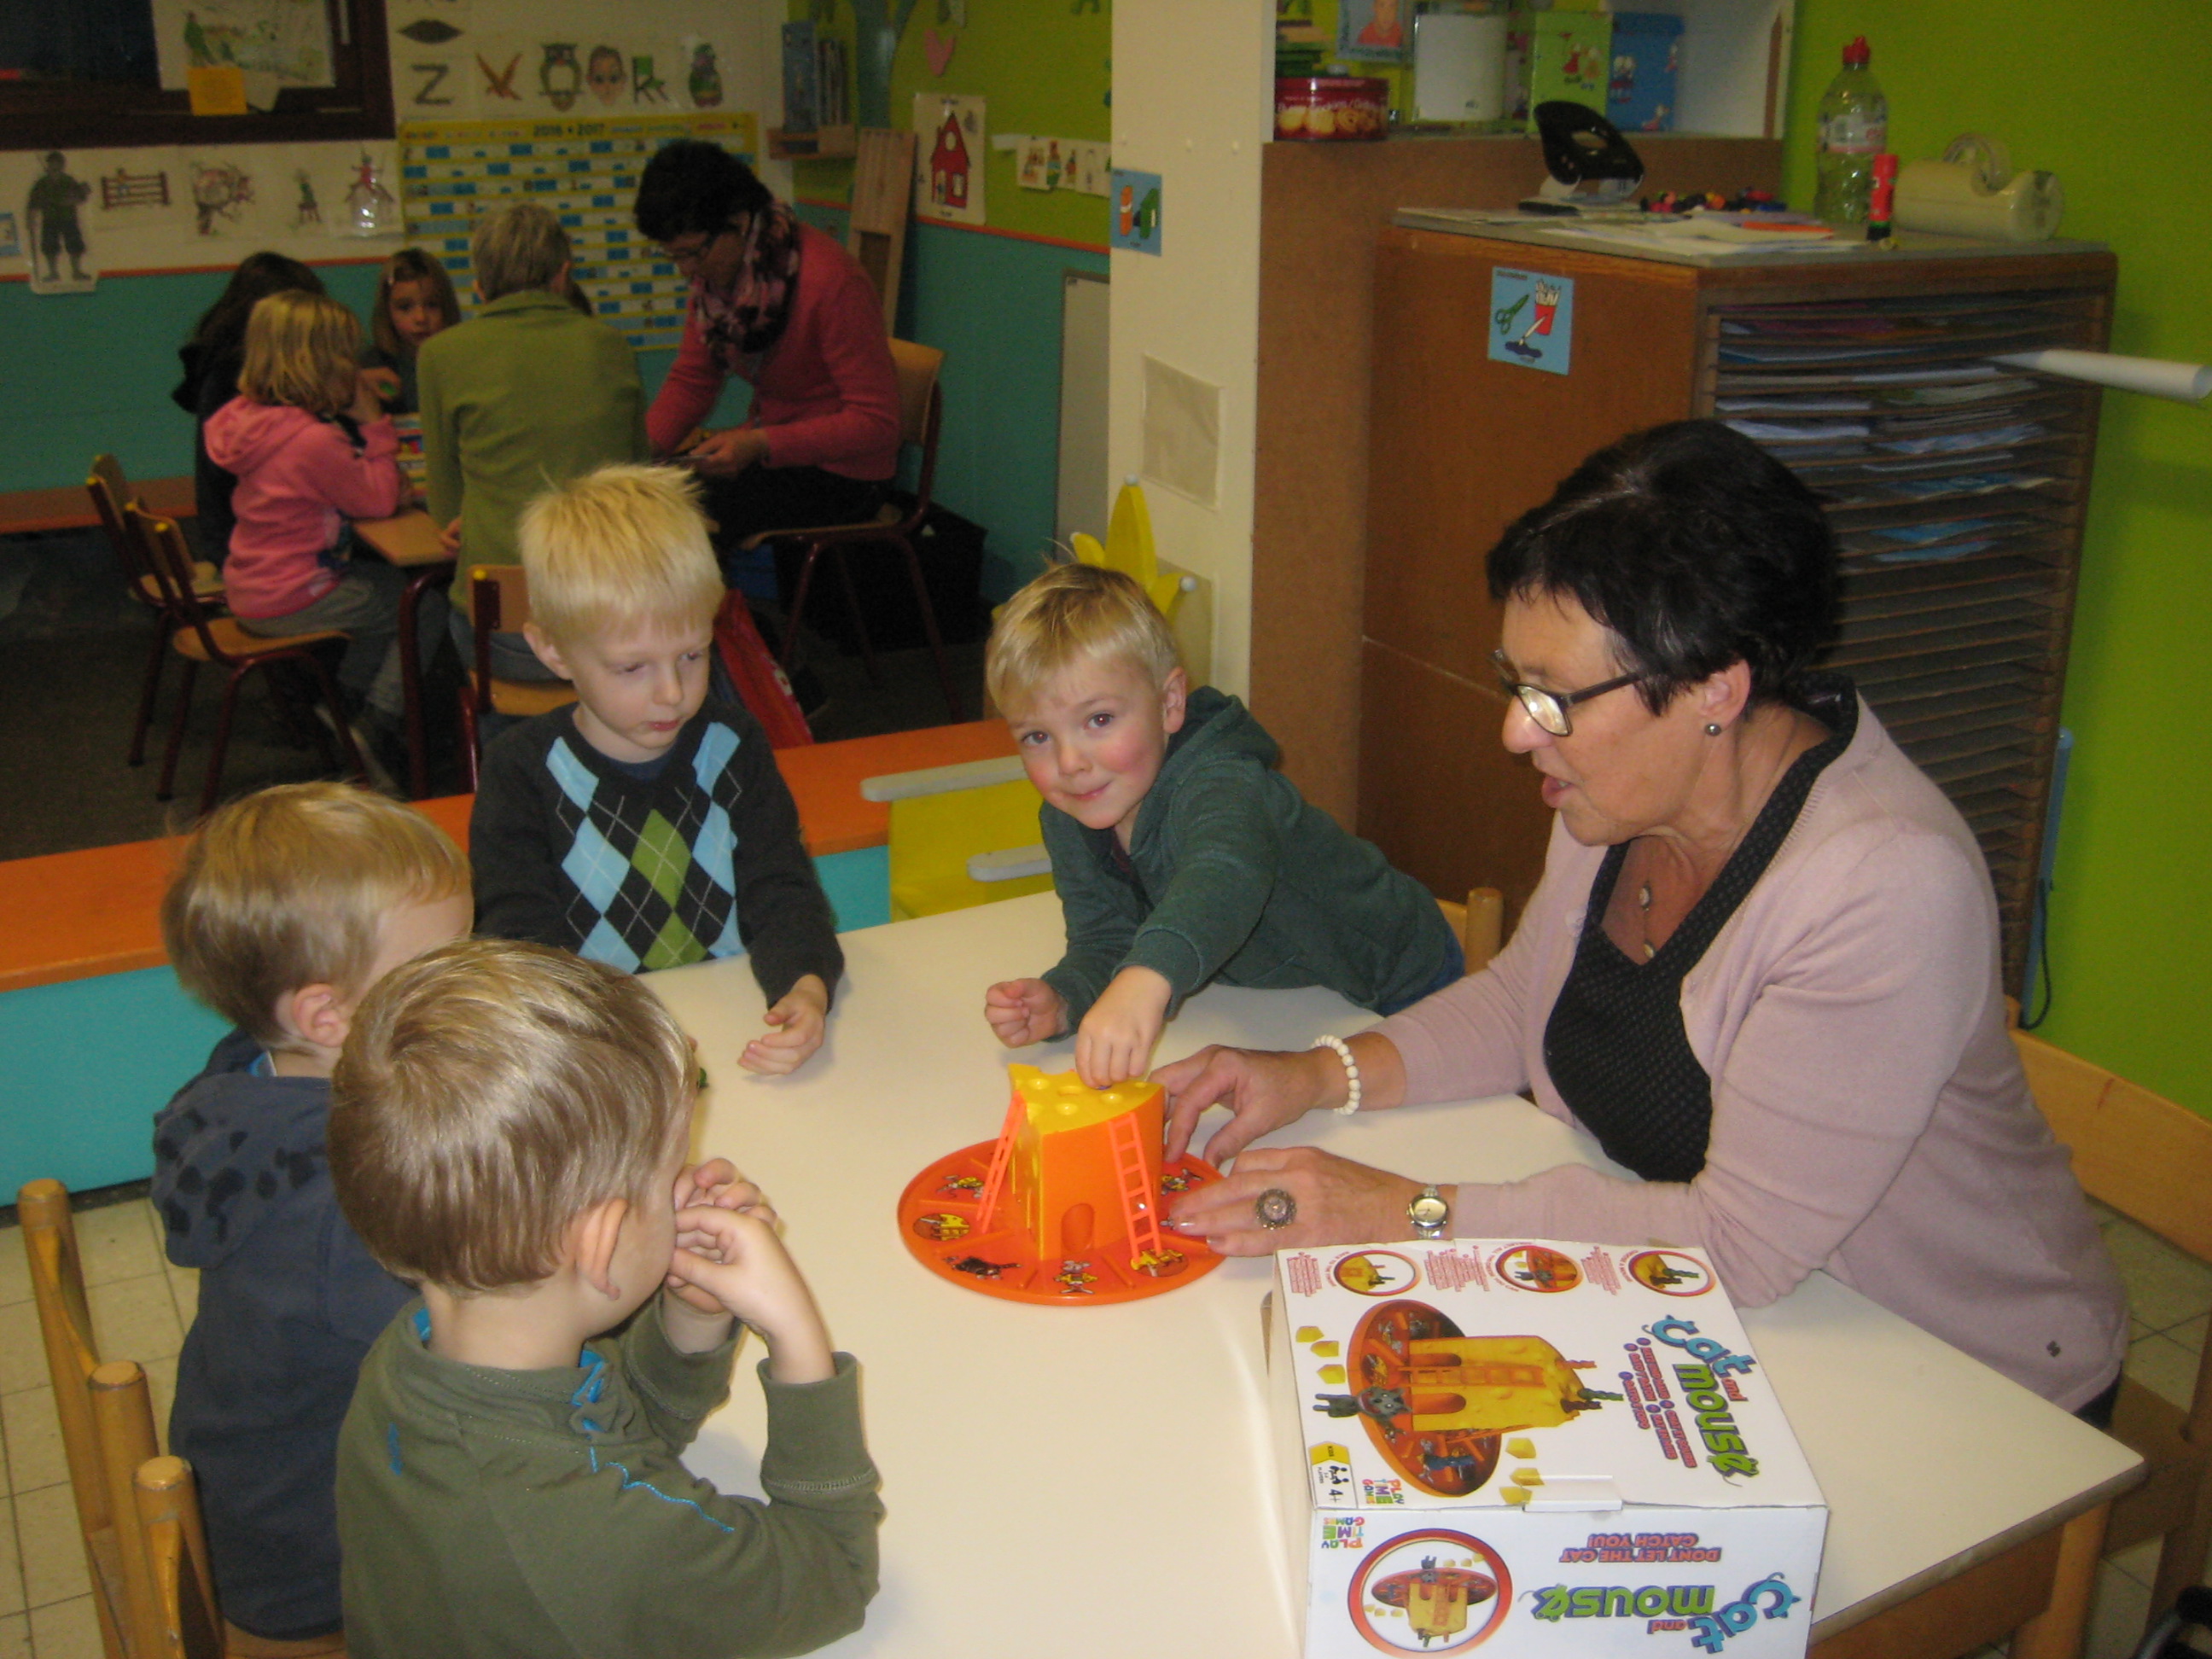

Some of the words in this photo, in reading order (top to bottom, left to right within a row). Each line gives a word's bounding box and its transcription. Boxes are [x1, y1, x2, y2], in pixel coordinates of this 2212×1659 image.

[1721, 1377, 1749, 1401] and
[1650, 1414, 1668, 1429] KAT
[1664, 1410, 1683, 1429] CHAT
[1674, 1365, 1760, 1476] mouse
[1656, 1429, 1670, 1441] EN
[1672, 1429, 1687, 1440] ET
[1676, 1439, 1697, 1468] SOURIS
[1329, 1489, 1343, 1503] 4+
[1362, 1479, 1374, 1504] GAMES
[1375, 1479, 1394, 1504] TIME
[1388, 1479, 1404, 1505] PLAY
[1324, 1516, 1365, 1526] GAMES
[1323, 1526, 1365, 1540] TIME
[1586, 1533, 1632, 1547] YOU!
[1634, 1533, 1698, 1547] CATCH
[1321, 1538, 1363, 1548] PLAY
[1559, 1548, 1598, 1563] CAT
[1599, 1549, 1633, 1563] THE
[1633, 1549, 1668, 1563] LET
[1668, 1547, 1721, 1563] DONT
[1531, 1585, 1714, 1623] mouse
[1647, 1620, 1688, 1634] and
